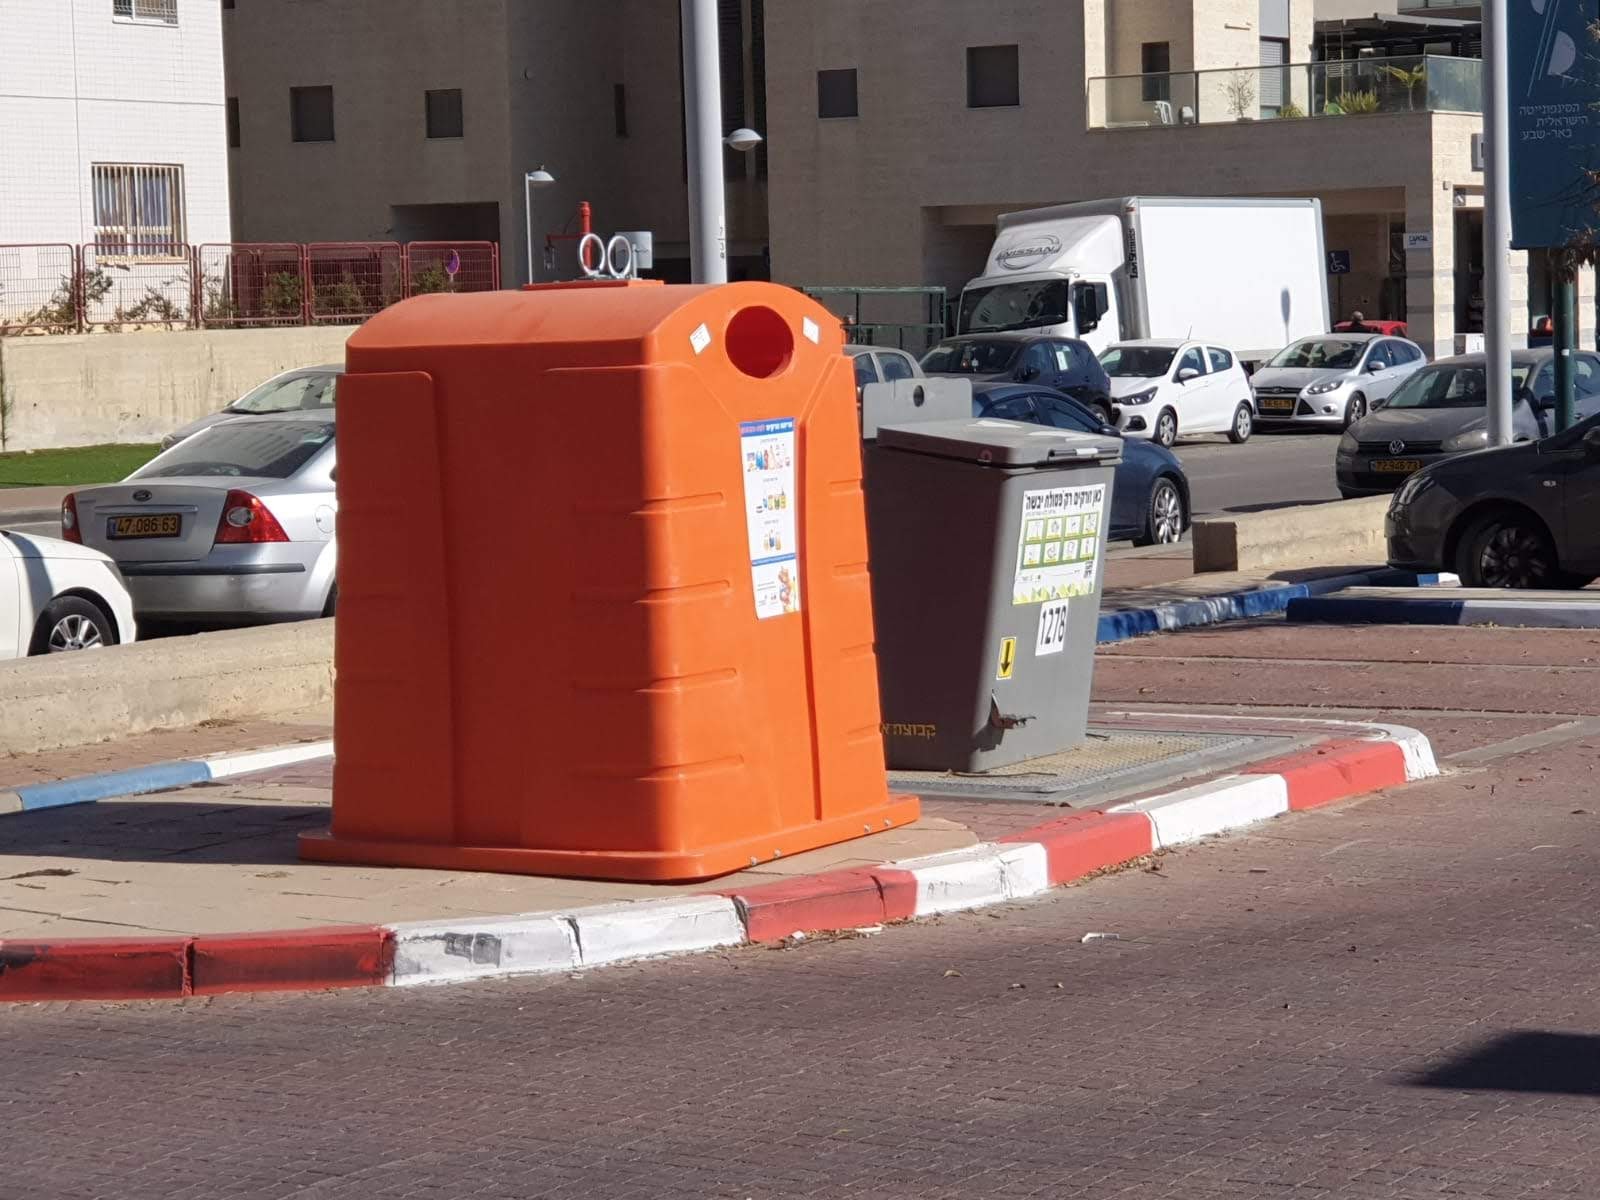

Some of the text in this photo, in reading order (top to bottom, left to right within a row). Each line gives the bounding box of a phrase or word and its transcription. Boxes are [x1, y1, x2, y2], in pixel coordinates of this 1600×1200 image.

[1536, 115, 1588, 127] הישראלית
[1520, 128, 1572, 140] באר-שבע
[1005, 246, 1056, 259] NISSAN
[1073, 490, 1093, 509] זורקים
[1040, 605, 1067, 645] 1278
